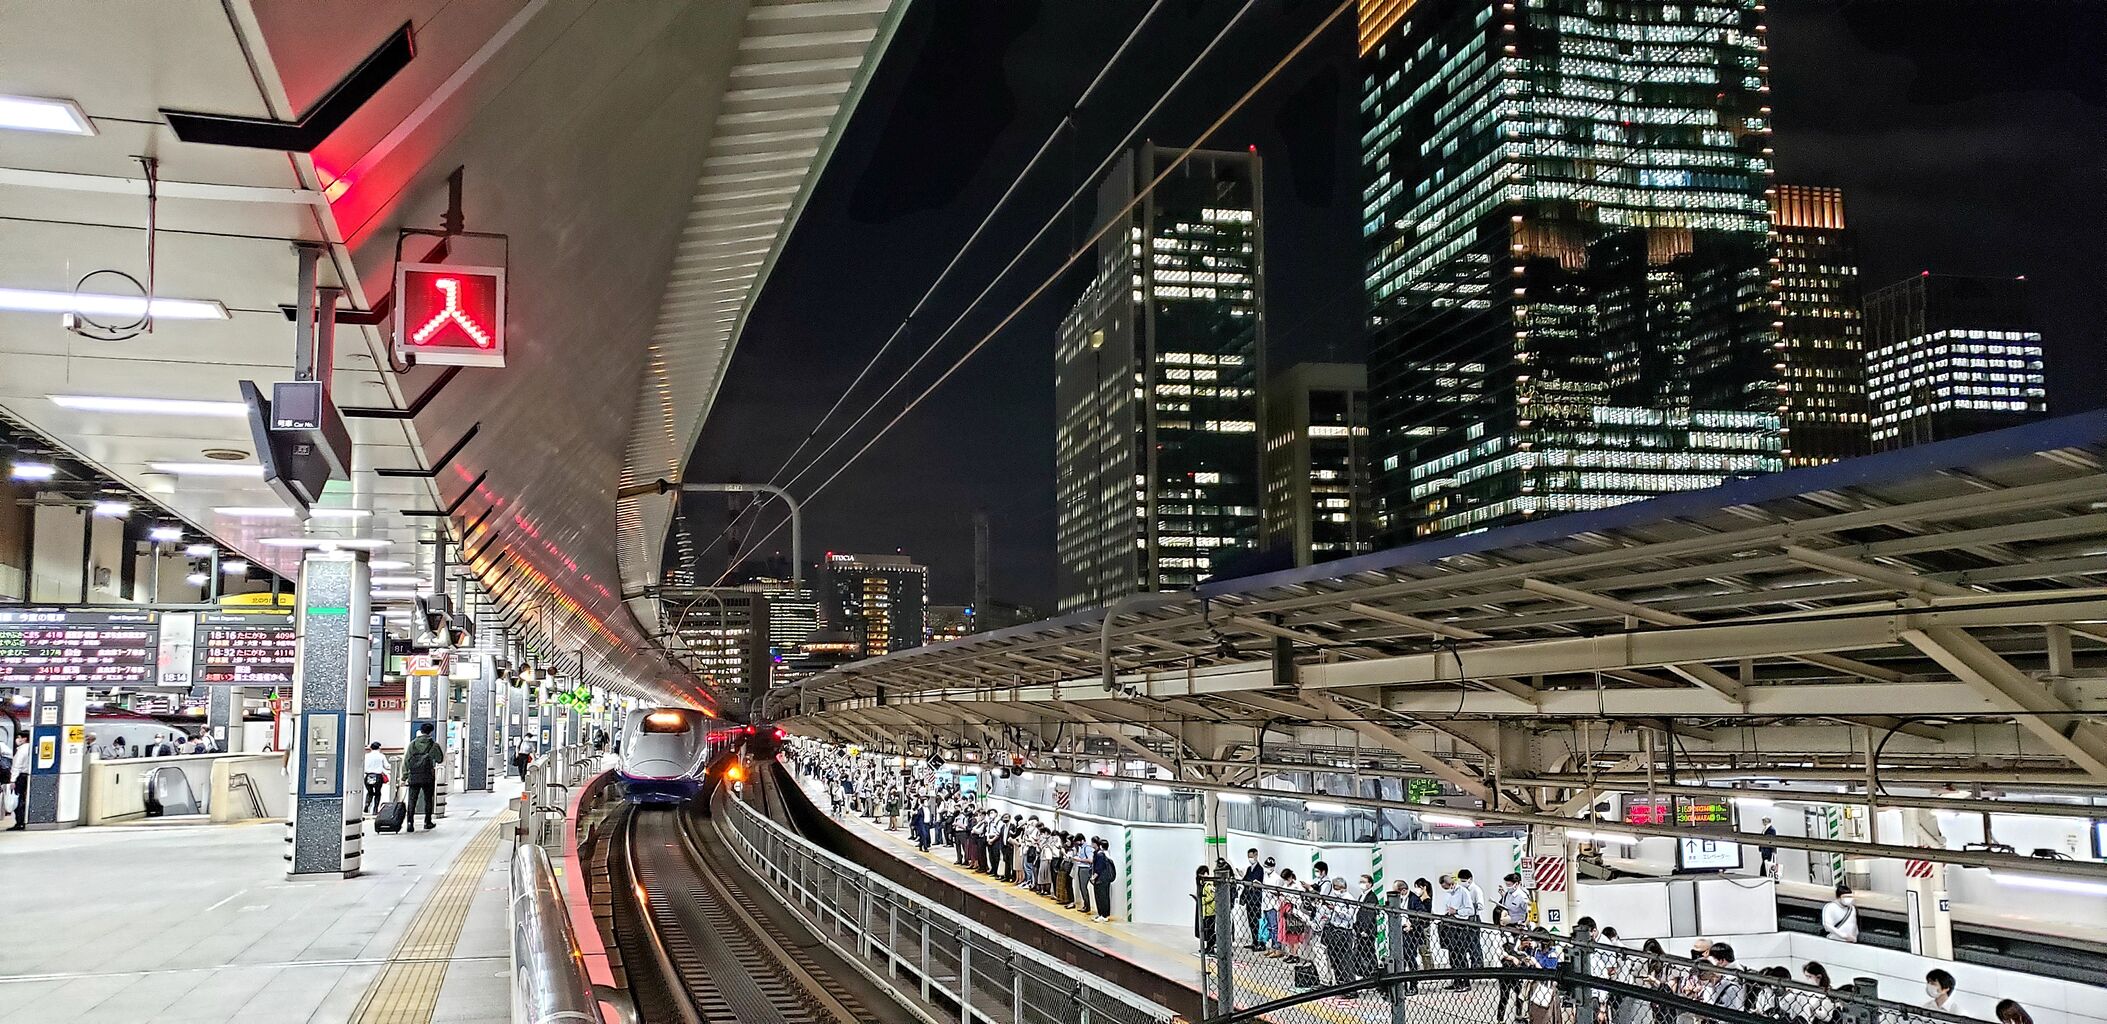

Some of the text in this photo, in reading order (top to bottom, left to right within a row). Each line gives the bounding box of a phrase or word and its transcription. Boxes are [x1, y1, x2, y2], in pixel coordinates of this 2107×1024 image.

[210, 631, 236, 640] 18:16
[164, 673, 188, 682] 18:14
[1549, 910, 1560, 921] 12
